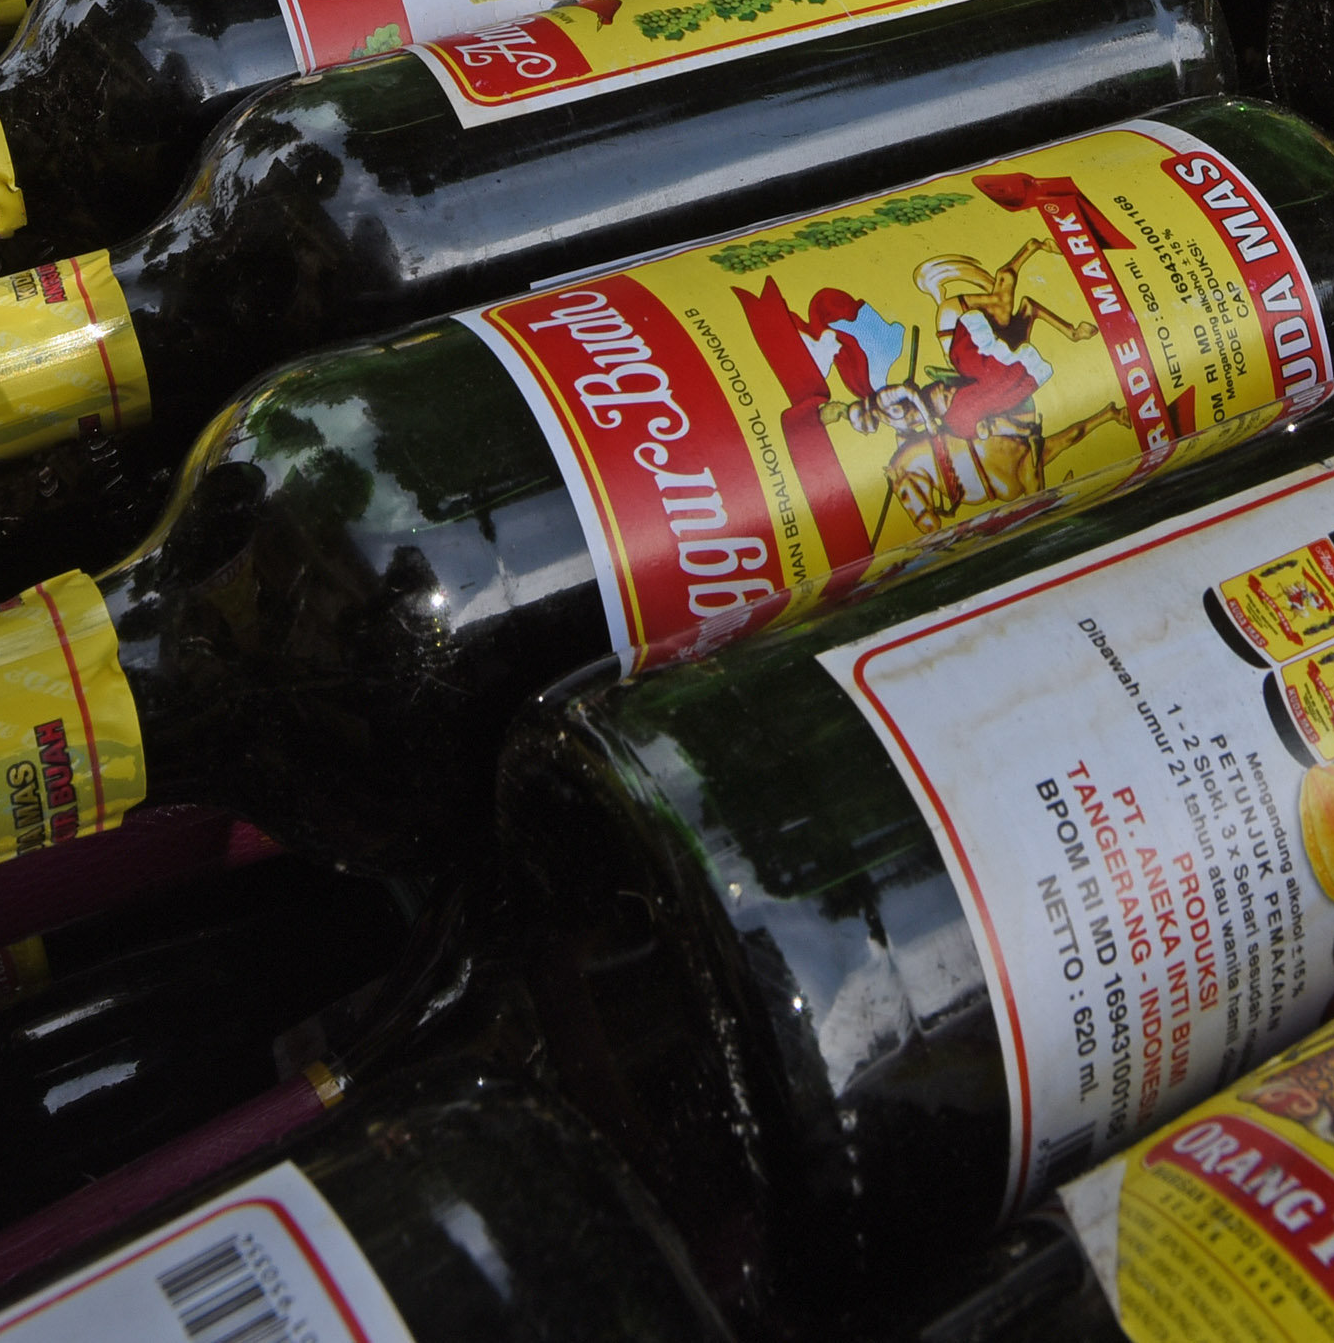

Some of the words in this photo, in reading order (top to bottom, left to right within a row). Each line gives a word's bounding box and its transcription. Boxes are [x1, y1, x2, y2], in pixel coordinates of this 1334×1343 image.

[1161, 226, 1174, 241] %
[1175, 156, 1280, 264] MAS
[1113, 194, 1190, 306] 169431001168
[1124, 255, 1147, 281] ml.
[1169, 240, 1185, 259] 15
[1186, 237, 1238, 325] PRODUKSI:
[684, 307, 701, 322] B
[1136, 280, 1161, 315] 620
[1225, 279, 1251, 320] CAP
[528, 289, 690, 441] Buah
[692, 316, 755, 407] GOLONGAN
[1157, 325, 1184, 390] NETTO
[1193, 324, 1214, 355] MD
[1223, 329, 1247, 378] KODE
[1205, 363, 1220, 386] RI
[747, 408, 800, 537] BERALKOHOL
[1166, 701, 1183, 718] 1
[1181, 733, 1203, 750] 2
[7, 760, 44, 829] MAS
[33, 717, 77, 810] BUAH
[1191, 752, 1225, 823] Sloki,
[1034, 776, 1092, 875] BPOM
[1077, 616, 1141, 700] Dibawah
[1135, 698, 1177, 757] umur
[1166, 754, 1192, 789] 21
[1182, 789, 1216, 862] tahun
[1206, 863, 1232, 916] atau
[1220, 918, 1241, 995] wanita
[1111, 784, 1149, 840] PT.
[1220, 822, 1239, 841] 3
[1066, 758, 1153, 967] TANGERANG
[1226, 843, 1241, 861] x
[1244, 750, 1295, 876] Mengandung
[1284, 870, 1308, 947] alkohol
[1075, 874, 1105, 917] RI
[1135, 843, 1184, 960] ANEKA
[1209, 732, 1275, 882] PETUNJUK
[1262, 890, 1285, 1033] PEMAKAIAN
[1231, 861, 1258, 941] Sehari
[1035, 873, 1087, 985] NETTO
[1087, 915, 1120, 969] MD
[1171, 850, 1221, 1013] PRODUKSI
[1166, 962, 1188, 1024] INTI
[1071, 1003, 1100, 1059] 620
[1168, 1023, 1193, 1088] BUMI
[1077, 1058, 1101, 1105] ml.
[1171, 1121, 1326, 1233] ORANG
